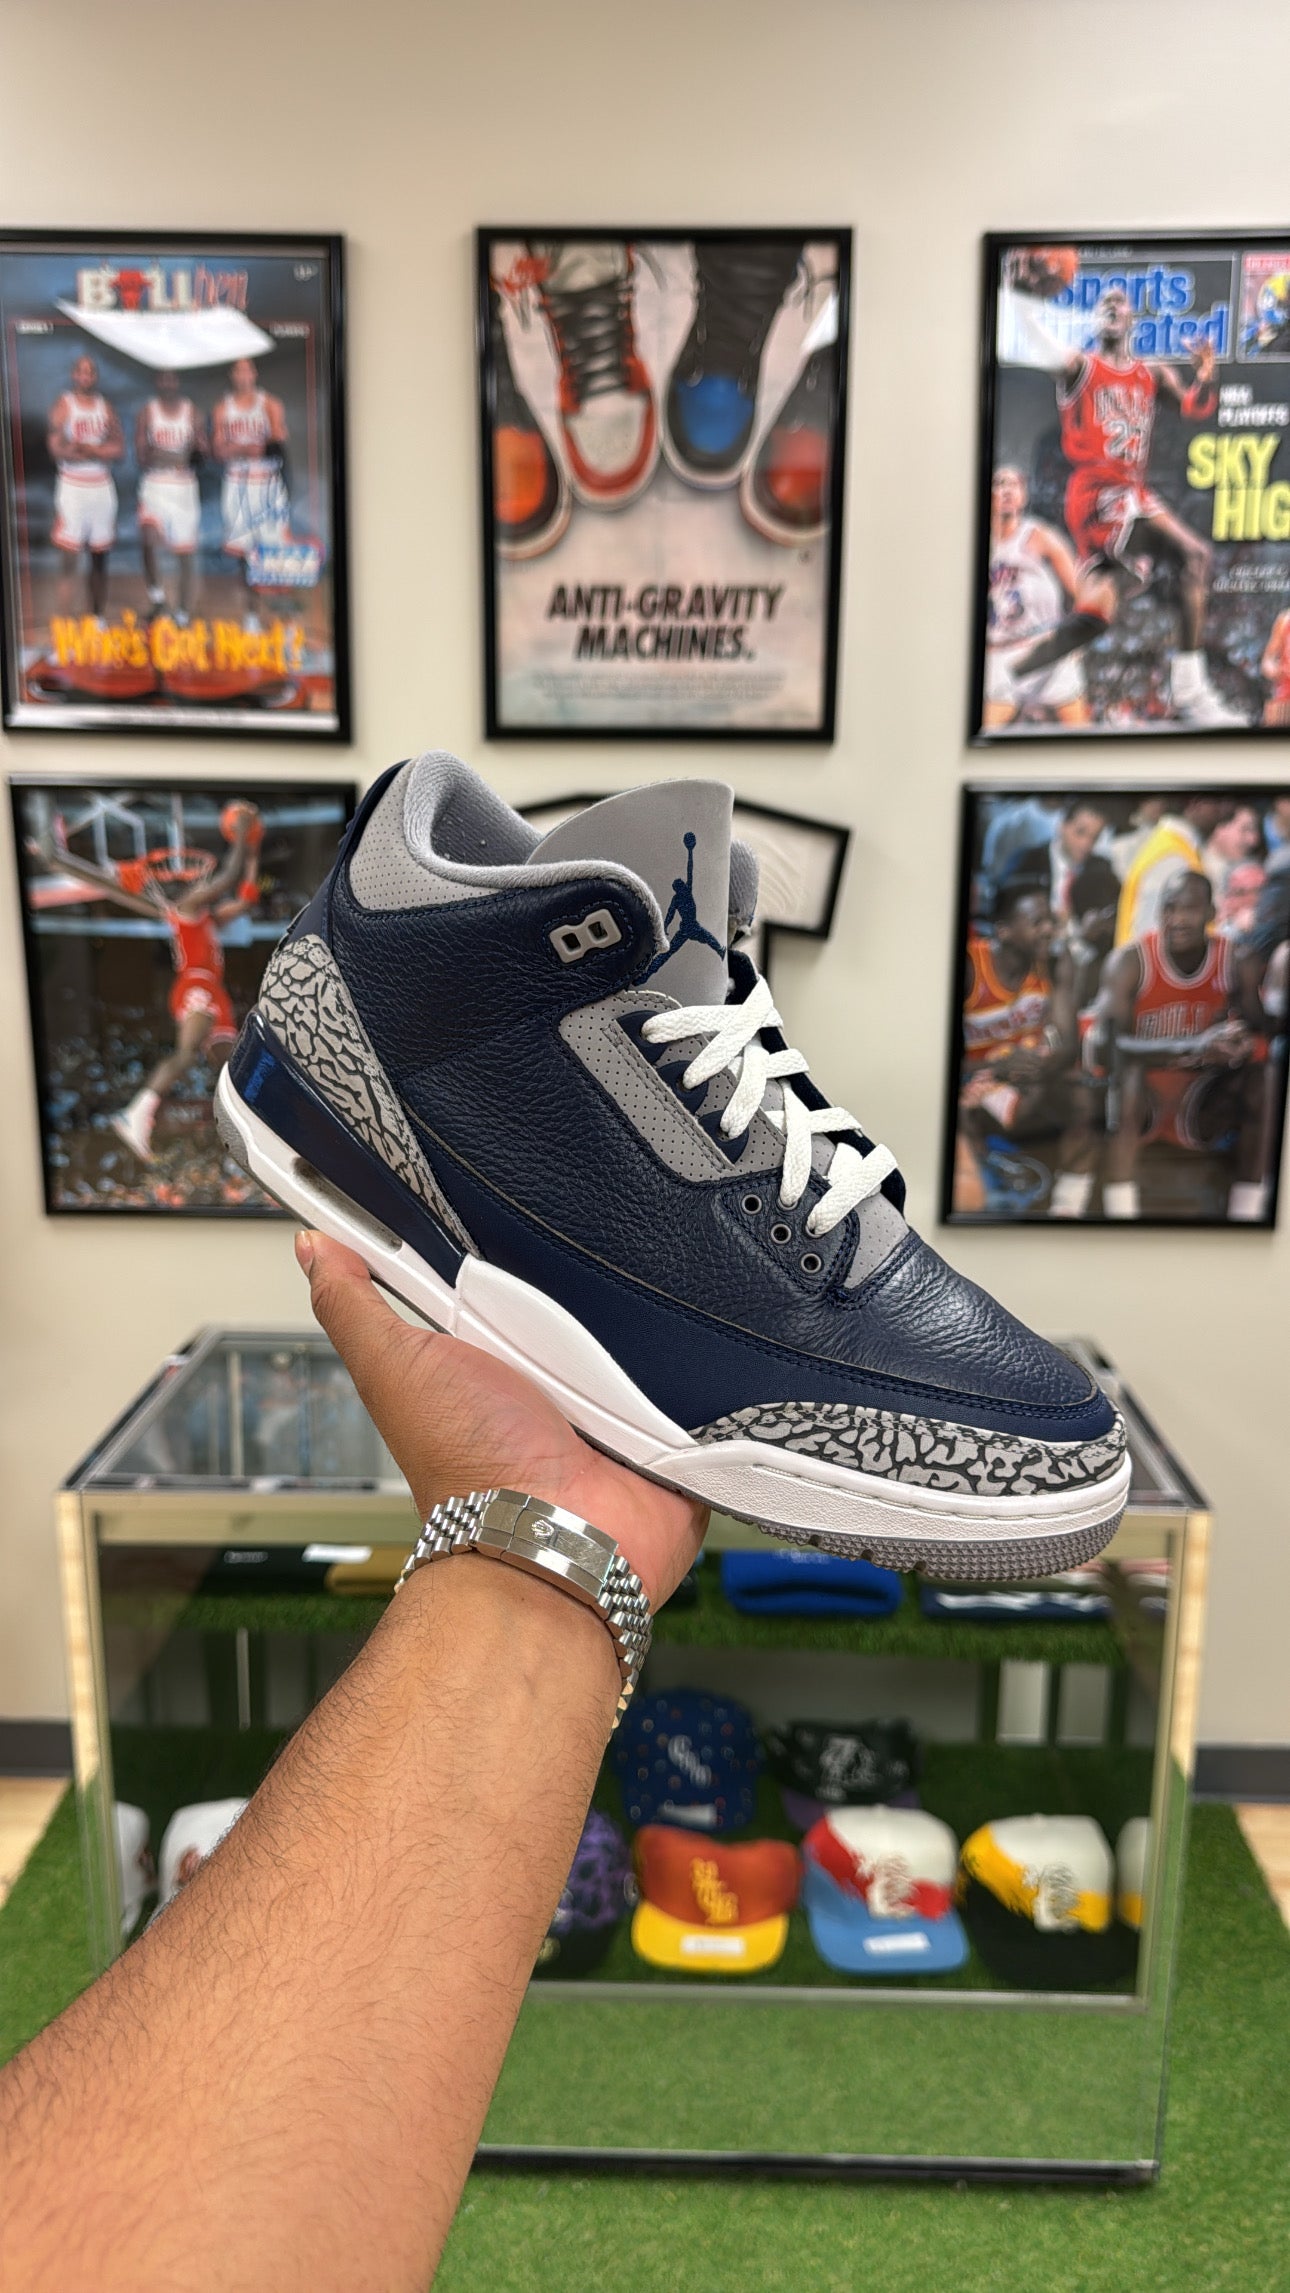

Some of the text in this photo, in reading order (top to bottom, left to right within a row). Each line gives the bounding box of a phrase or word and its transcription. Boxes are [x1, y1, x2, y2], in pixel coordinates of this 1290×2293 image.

[1187, 432, 1281, 489] SKY
[547, 583, 784, 620] ANTI-GRAVITY
[52, 609, 148, 670] Who's
[151, 616, 210, 672] Got
[573, 625, 756, 662] MACHINES.
